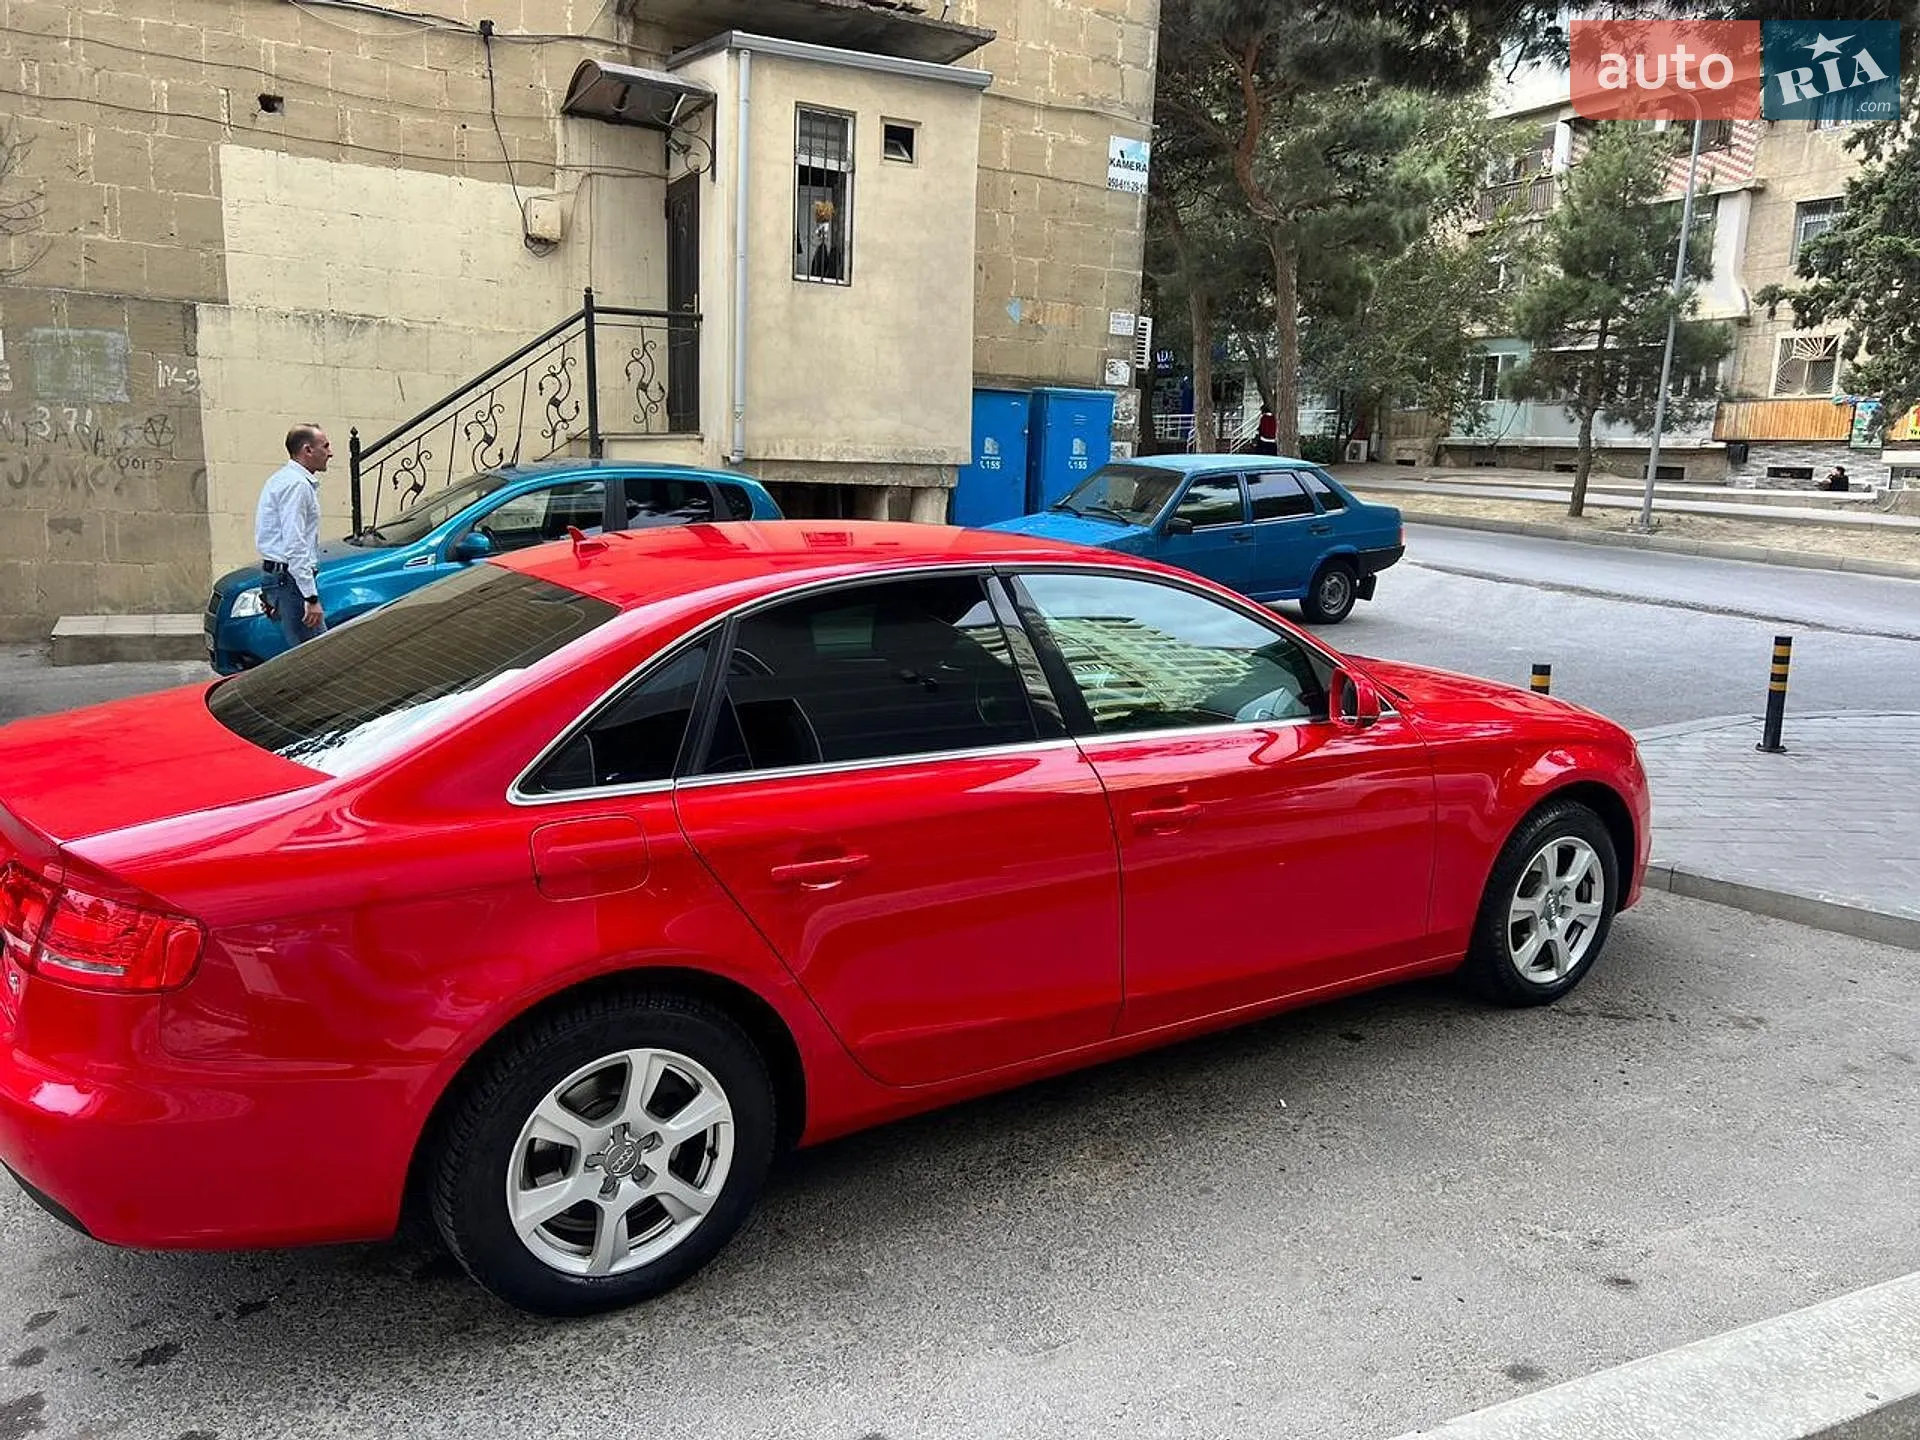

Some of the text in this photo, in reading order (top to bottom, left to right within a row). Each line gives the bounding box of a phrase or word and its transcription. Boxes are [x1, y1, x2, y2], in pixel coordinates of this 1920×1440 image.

[1109, 157, 1149, 173] KAMERA
[986, 460, 1001, 470] 155
[1073, 460, 1088, 470] 155
